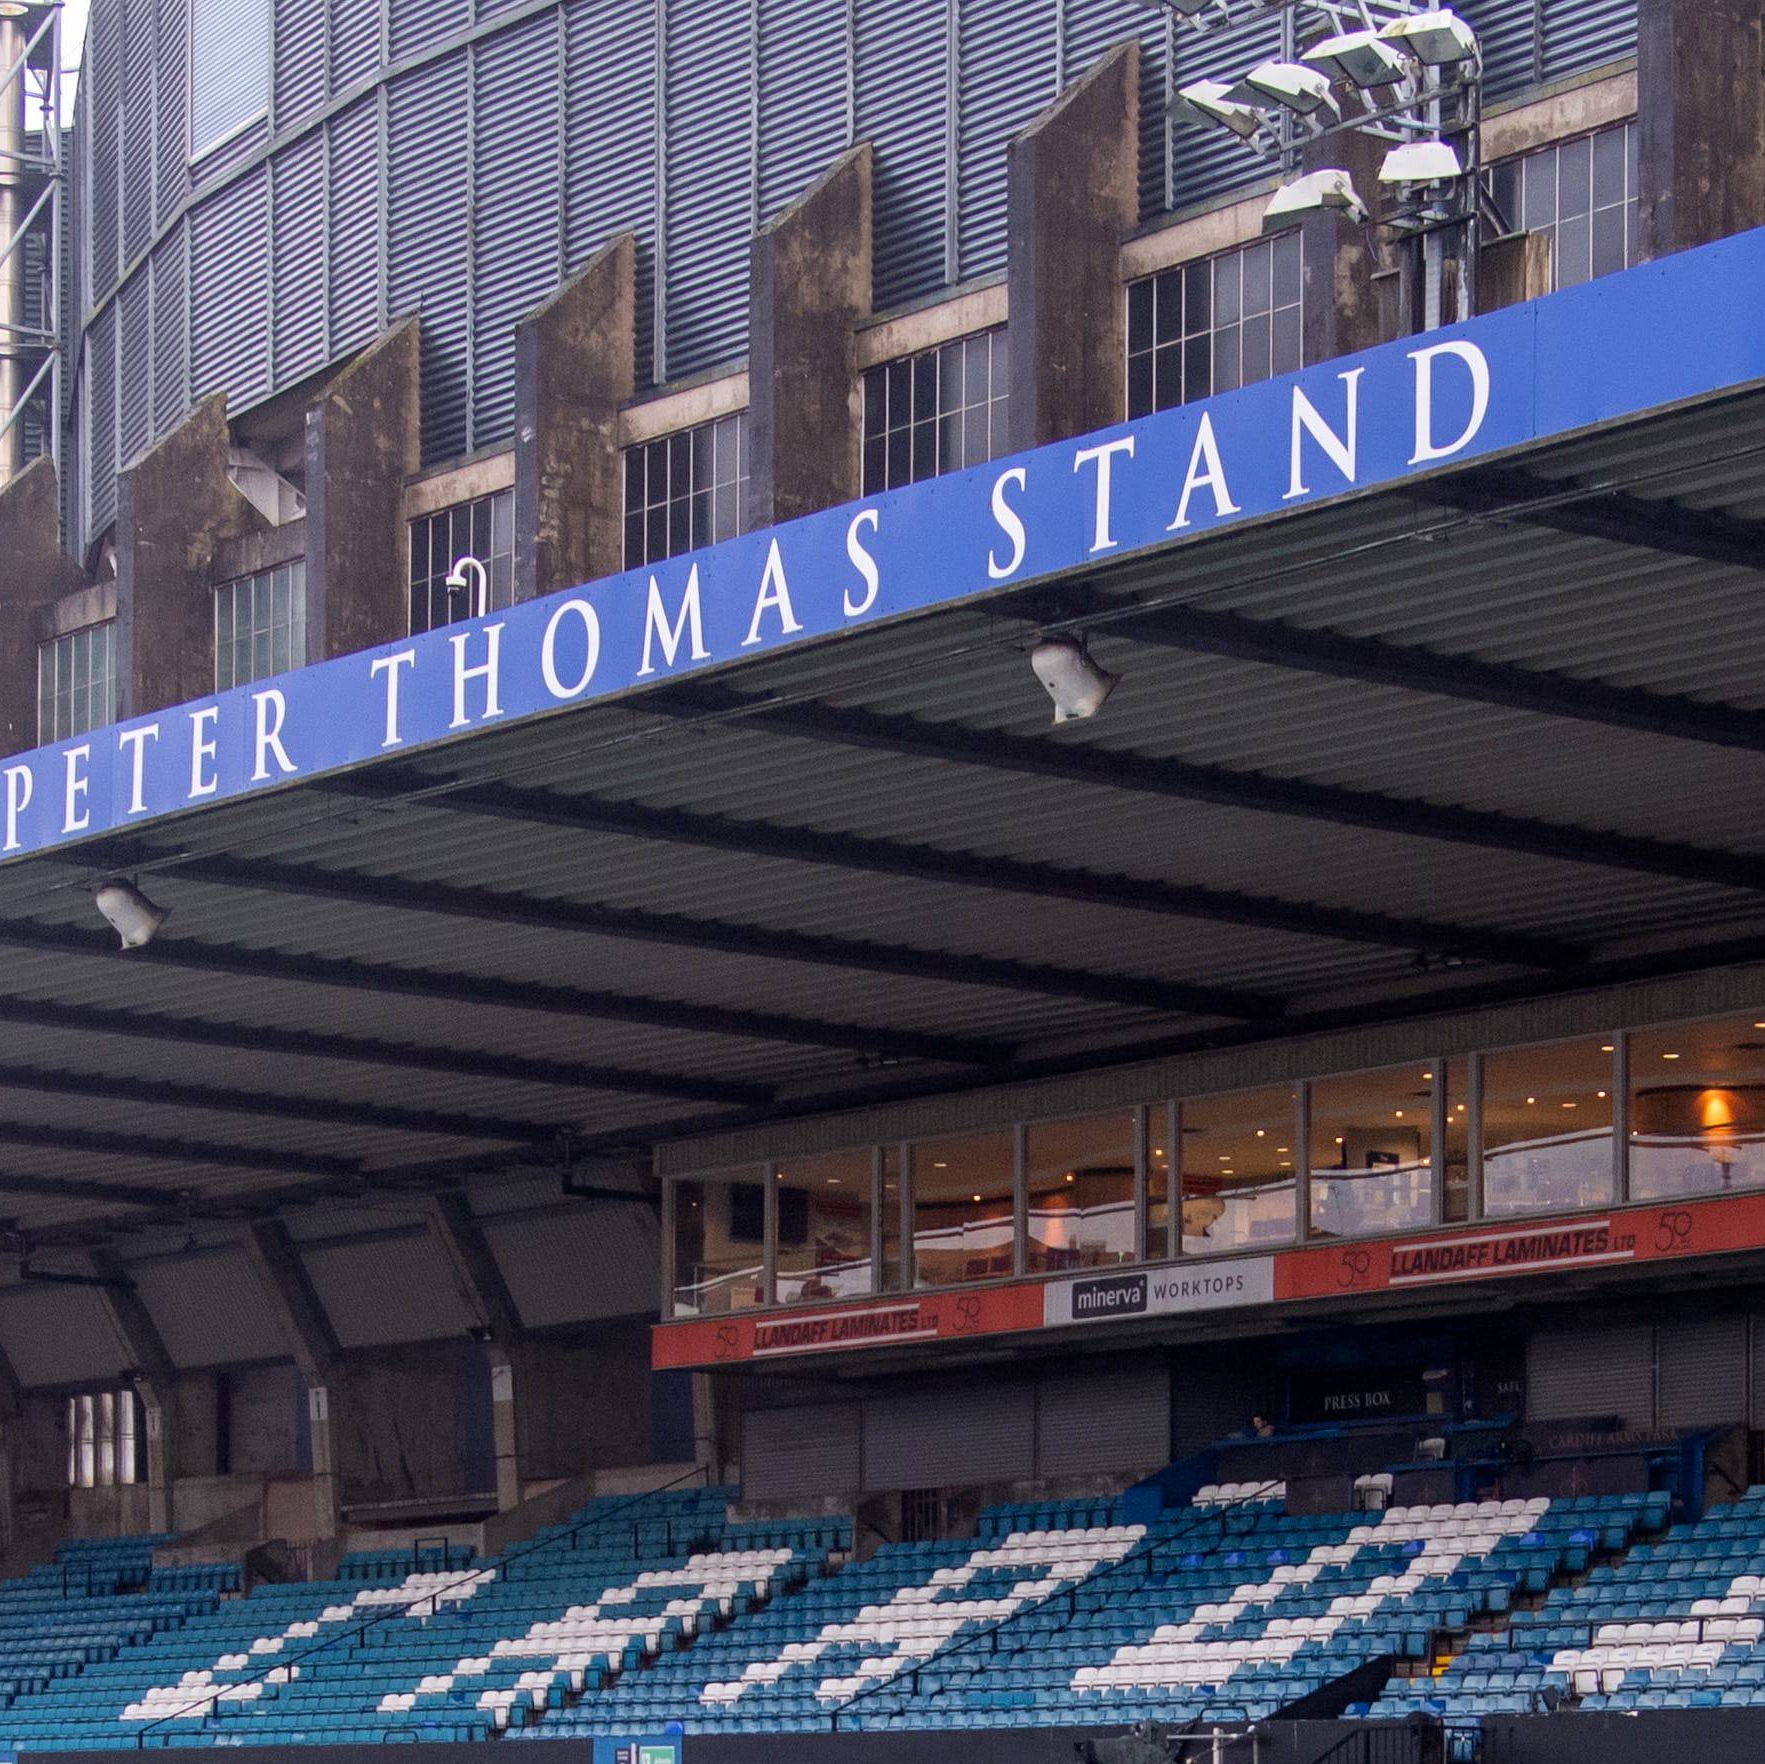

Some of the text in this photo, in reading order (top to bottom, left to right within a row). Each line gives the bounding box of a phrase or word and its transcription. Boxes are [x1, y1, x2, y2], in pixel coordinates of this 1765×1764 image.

[2, 690, 298, 856] PETER
[371, 510, 884, 750] THOMAS
[986, 340, 1494, 578] STAND
[1391, 1228, 1636, 1276] LLANDAFF LAMINATES LTD
[1077, 1274, 1244, 1310] minerva WORKTOPS
[754, 1317, 828, 1349] LLANDAFF
[831, 1308, 919, 1341] LAMINATES
[1324, 1391, 1391, 1412] PRESS BOX
